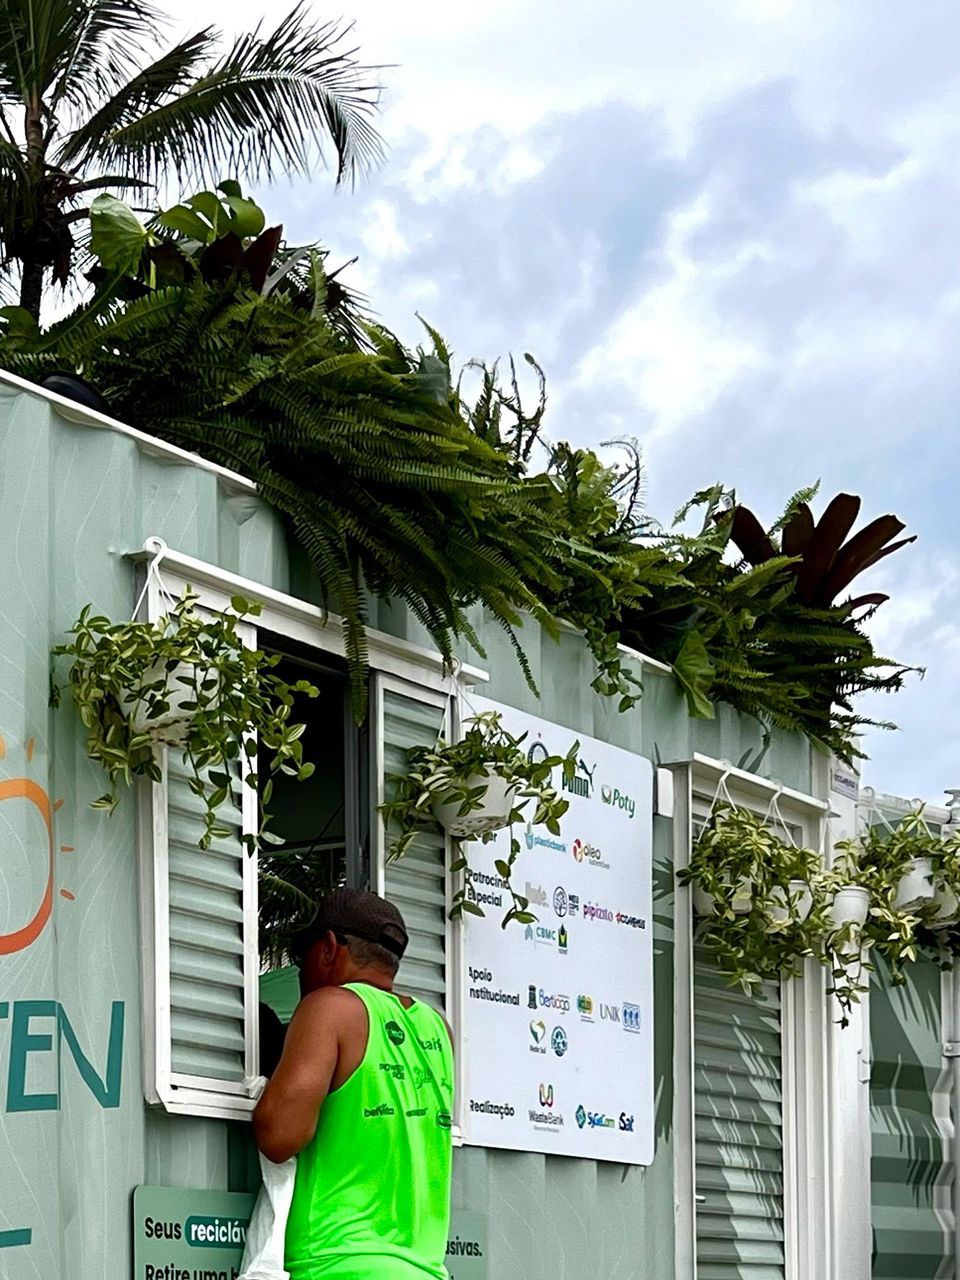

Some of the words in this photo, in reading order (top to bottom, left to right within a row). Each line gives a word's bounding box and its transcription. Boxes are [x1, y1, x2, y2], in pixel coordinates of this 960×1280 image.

[612, 788, 636, 819] Poty
[469, 987, 520, 1006] nstitucional
[469, 1099, 515, 1120] Realização
[144, 1216, 182, 1240] Seus
